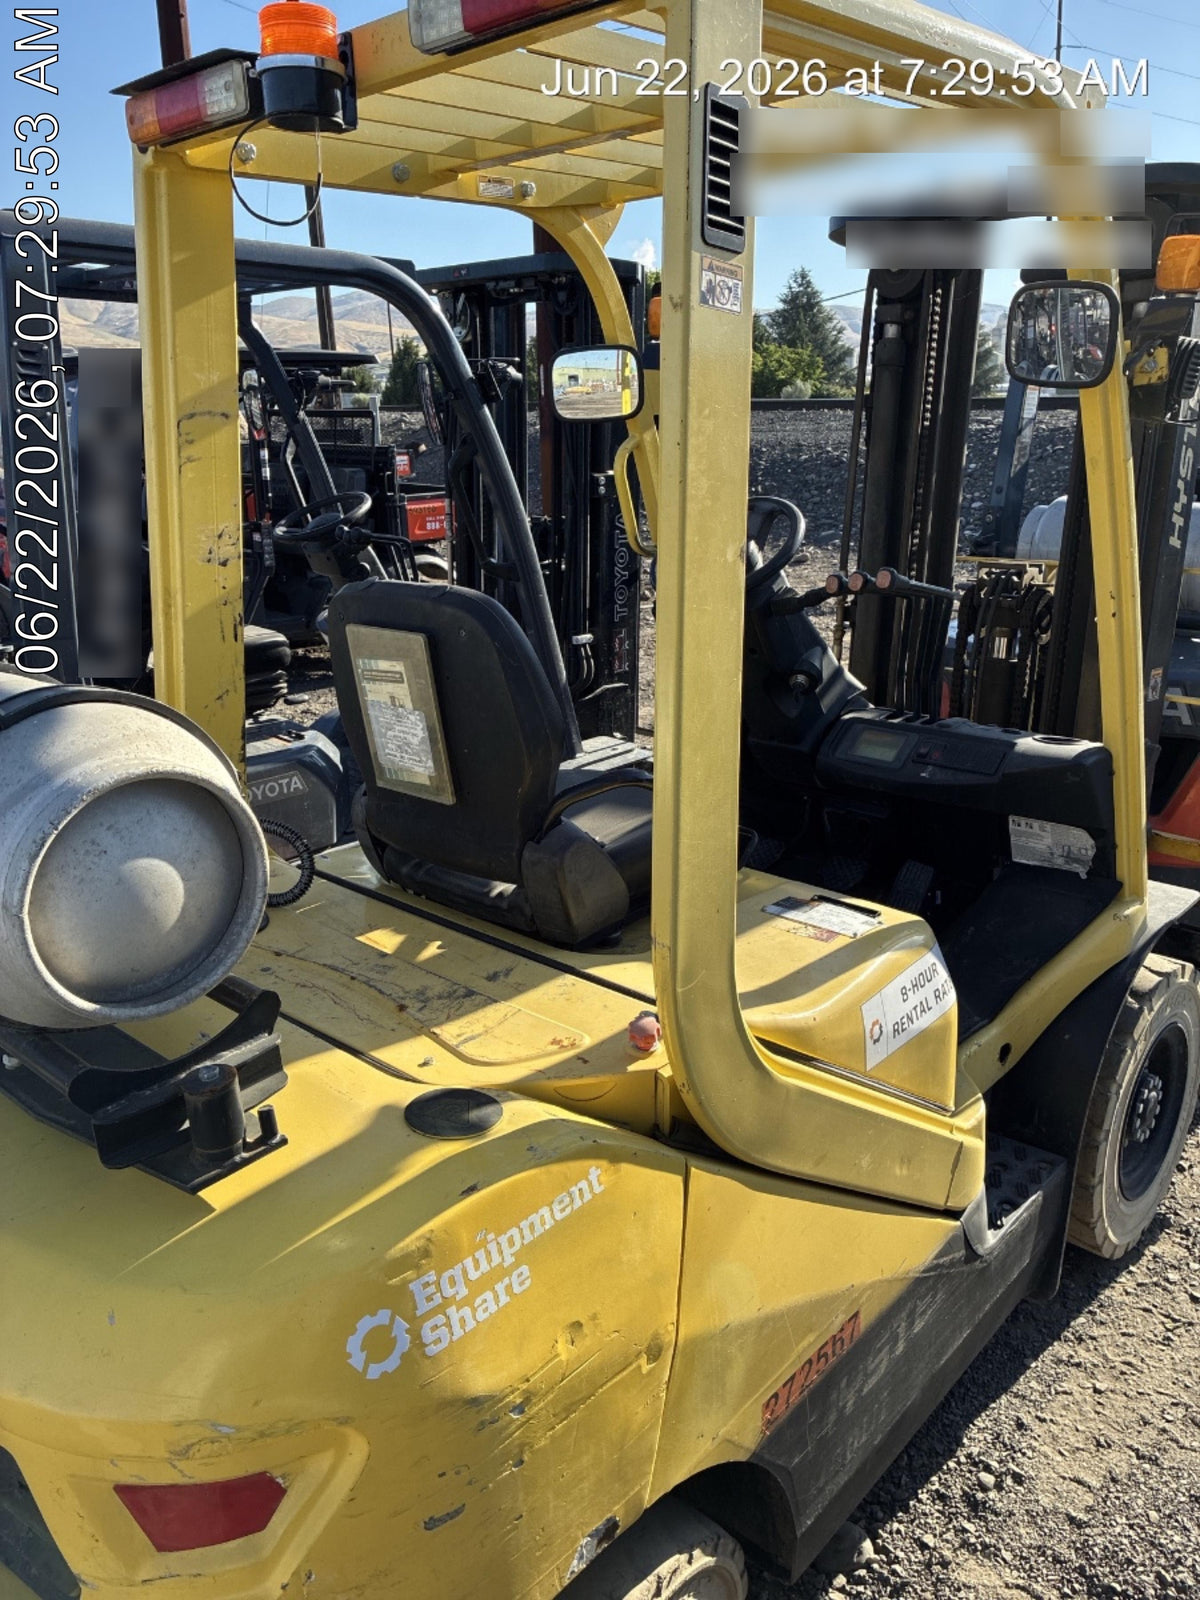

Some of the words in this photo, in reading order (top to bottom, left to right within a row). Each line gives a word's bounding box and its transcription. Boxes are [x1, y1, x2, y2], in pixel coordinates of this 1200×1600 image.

[1168, 400, 1198, 549] HYST
[892, 996, 933, 1040] RENTAL
[900, 962, 940, 1003] 8-HOUR
[408, 1165, 605, 1317] Equipment
[420, 1264, 533, 1357] Share
